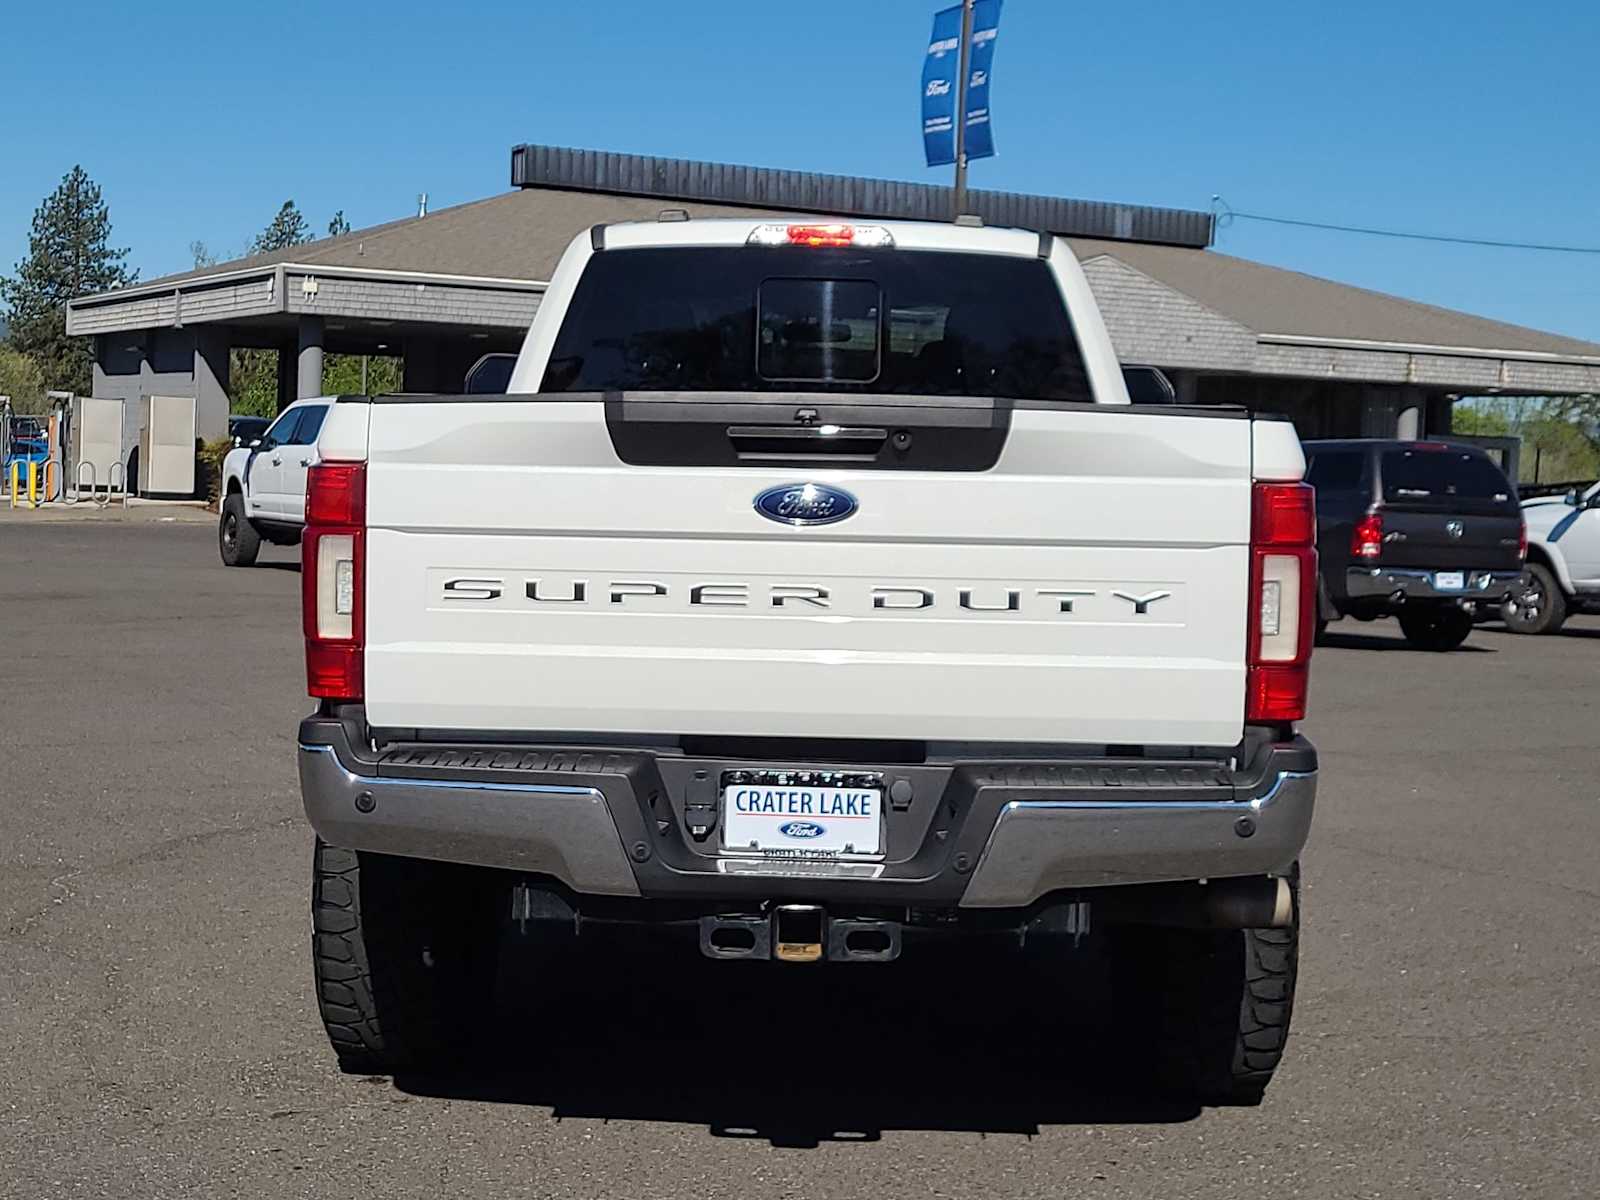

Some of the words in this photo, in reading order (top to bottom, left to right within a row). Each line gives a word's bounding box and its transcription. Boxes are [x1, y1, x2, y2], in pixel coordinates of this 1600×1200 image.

[927, 80, 950, 97] Ford
[443, 578, 830, 608] SUPER
[871, 585, 1172, 615] DUTY
[736, 790, 812, 813] CRATER
[820, 793, 871, 815] LAKE
[786, 822, 818, 837] Ford
